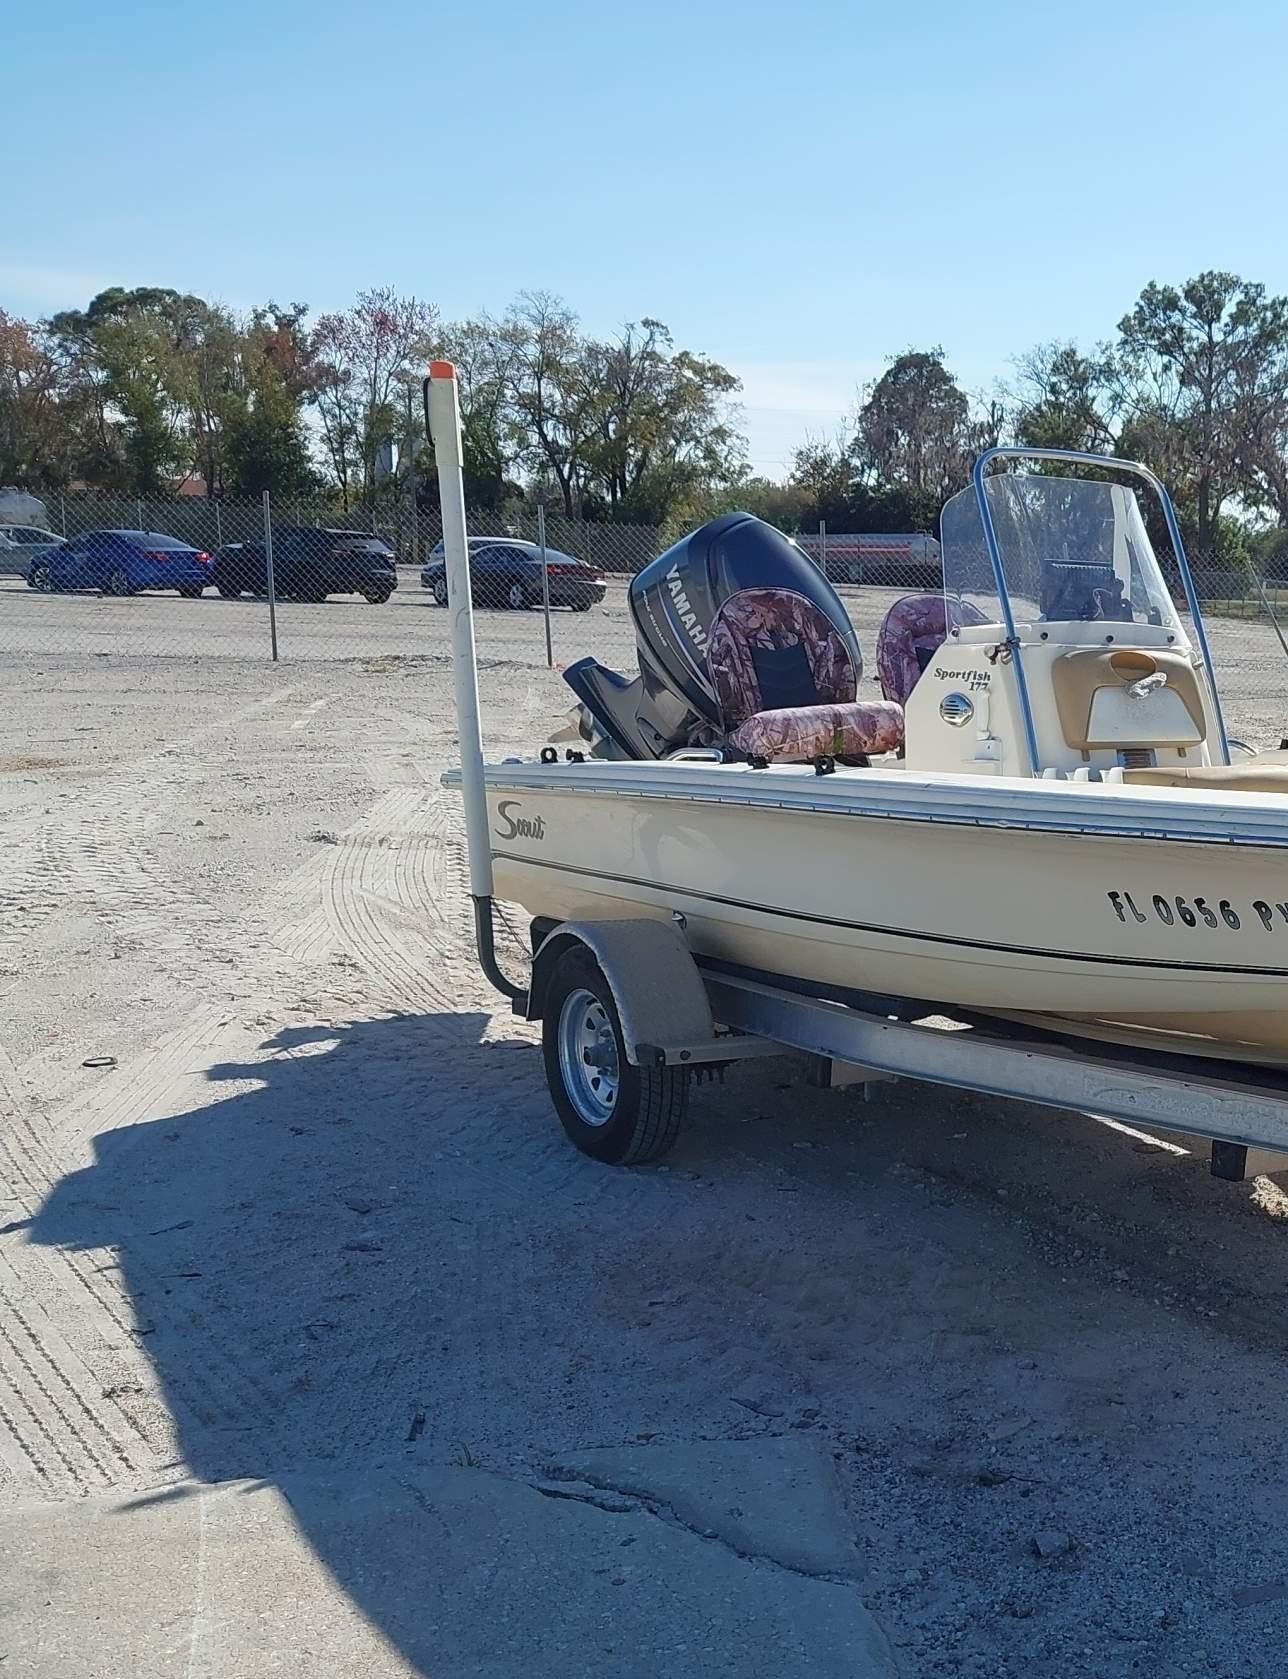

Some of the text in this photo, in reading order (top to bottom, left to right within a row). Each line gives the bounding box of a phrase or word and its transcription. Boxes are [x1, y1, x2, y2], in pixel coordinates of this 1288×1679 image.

[934, 667, 991, 682] Sportfish
[968, 681, 989, 692] 177
[494, 800, 546, 841] Scout
[1106, 890, 1148, 924] FL
[1151, 893, 1242, 931] 0656
